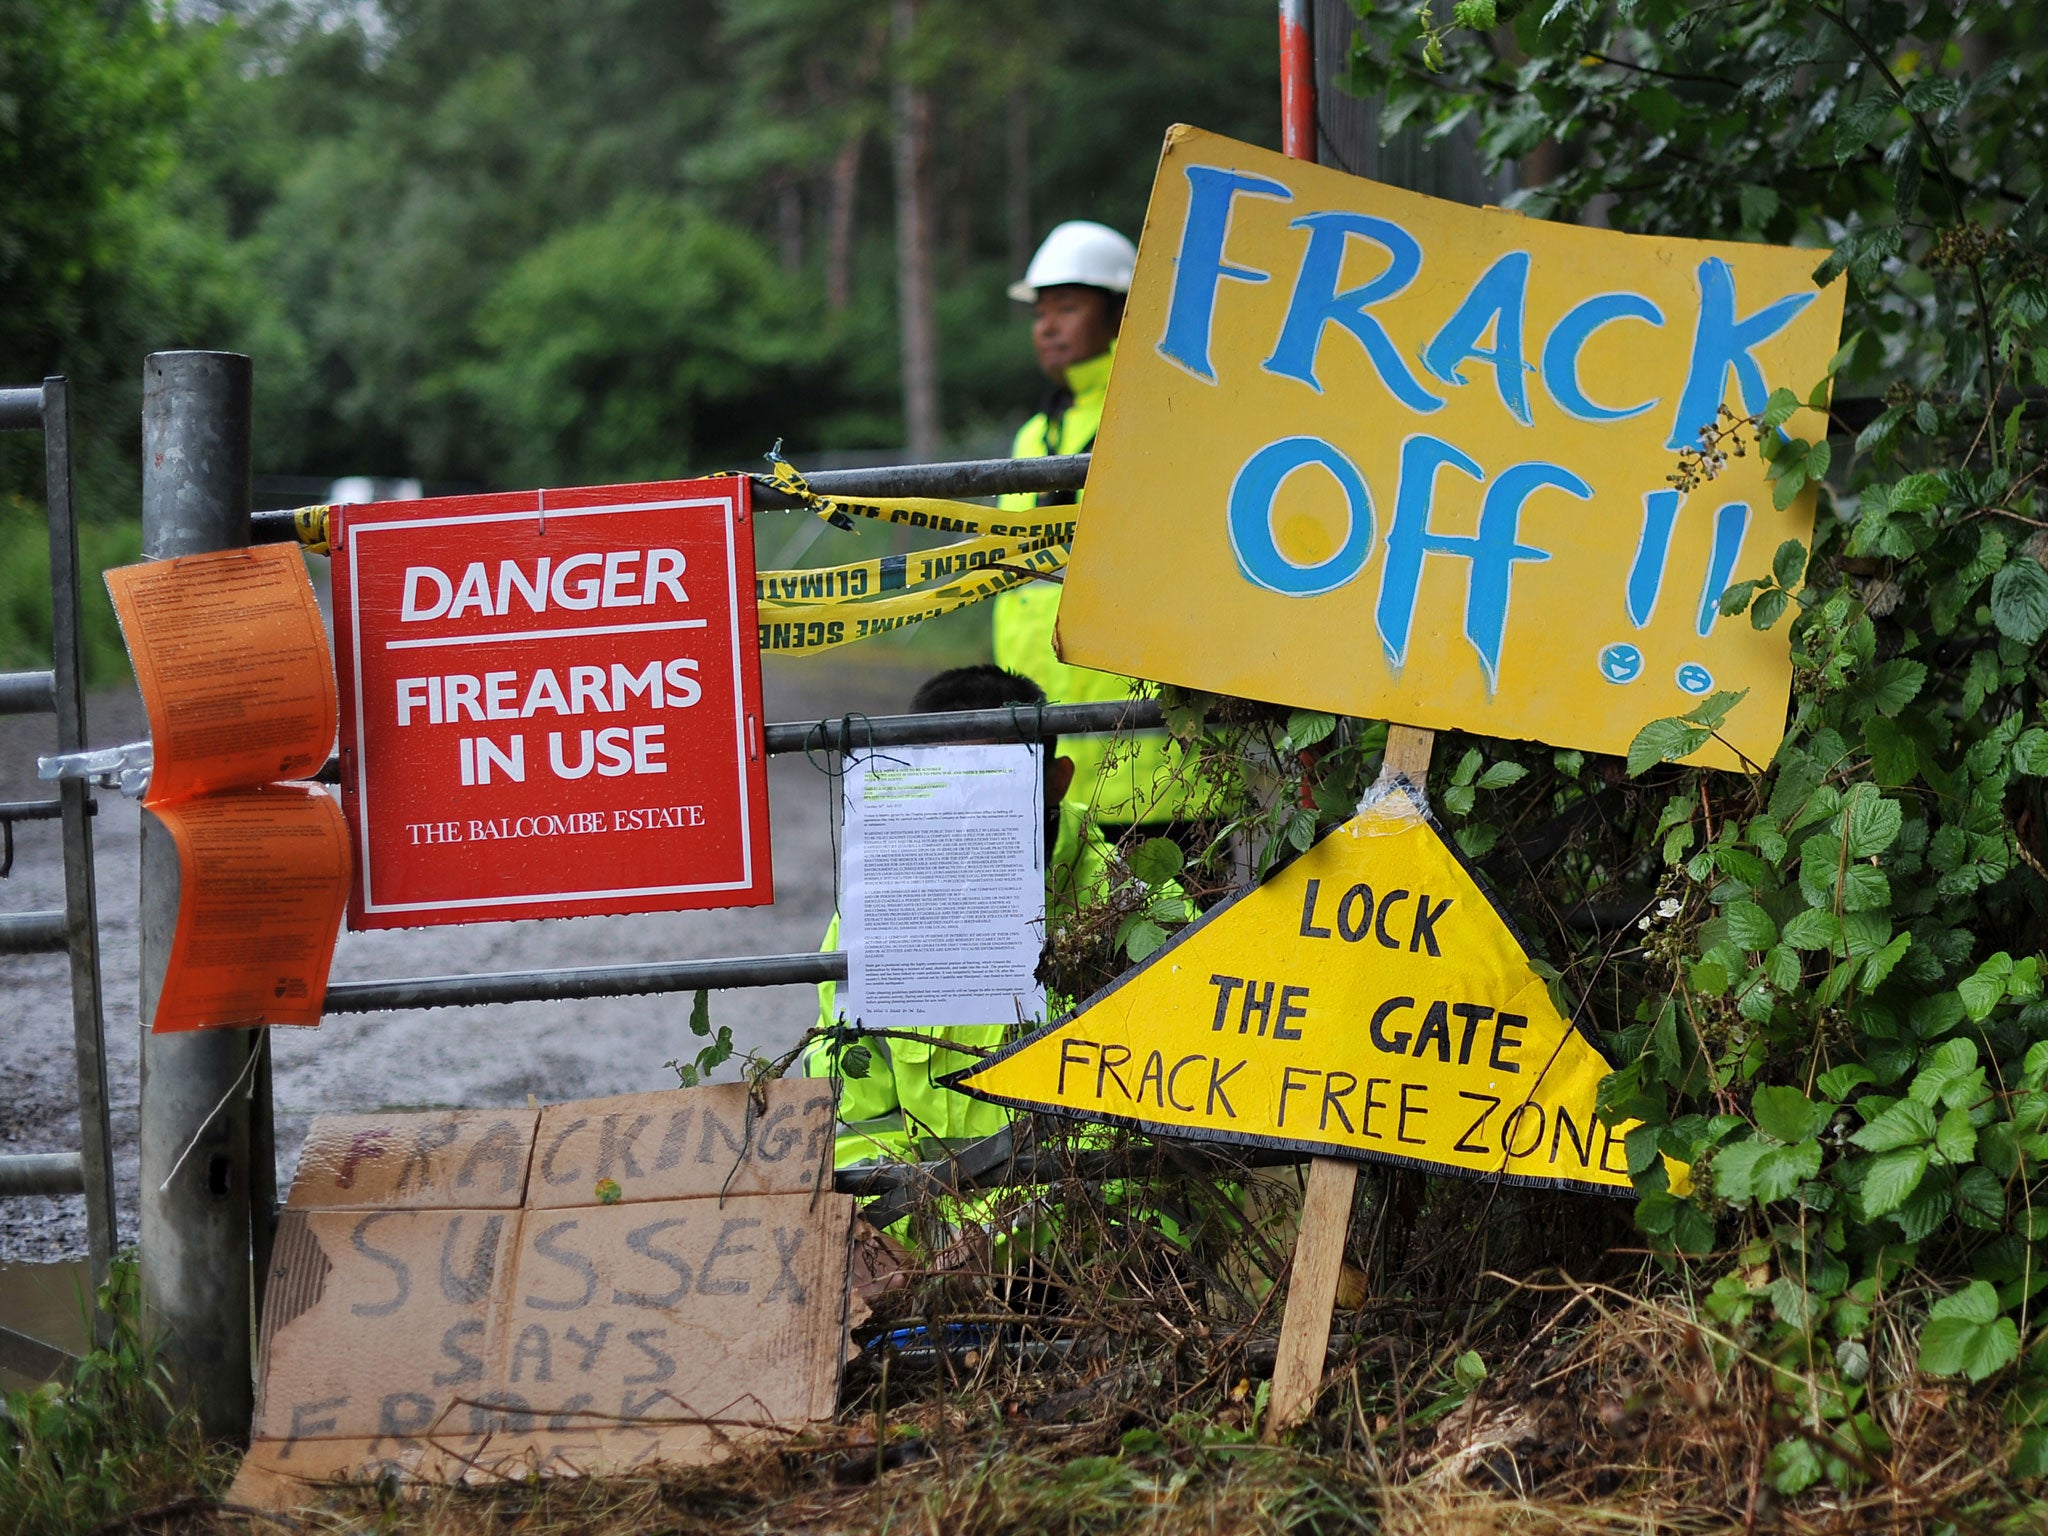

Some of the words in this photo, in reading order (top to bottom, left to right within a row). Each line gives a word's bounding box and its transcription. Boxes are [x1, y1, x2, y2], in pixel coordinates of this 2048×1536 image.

[1155, 164, 1819, 451] FRACK
[400, 548, 690, 623] DANGER
[760, 621, 845, 649] SCENE
[396, 658, 701, 727] FIREARMS
[459, 734, 526, 786] IN
[548, 724, 668, 780] USE
[406, 821, 463, 845] THE
[468, 810, 607, 842] BALCOMBE
[614, 805, 706, 832] ESTATE
[1299, 878, 1455, 958] LOCK
[1208, 973, 1311, 1042] THE
[1369, 995, 1529, 1075] GATE
[1057, 1037, 1248, 1119] FRACK
[1278, 1066, 1430, 1145] FREE
[350, 1211, 807, 1317] SUSSEX
[433, 1320, 677, 1387] SAYS
